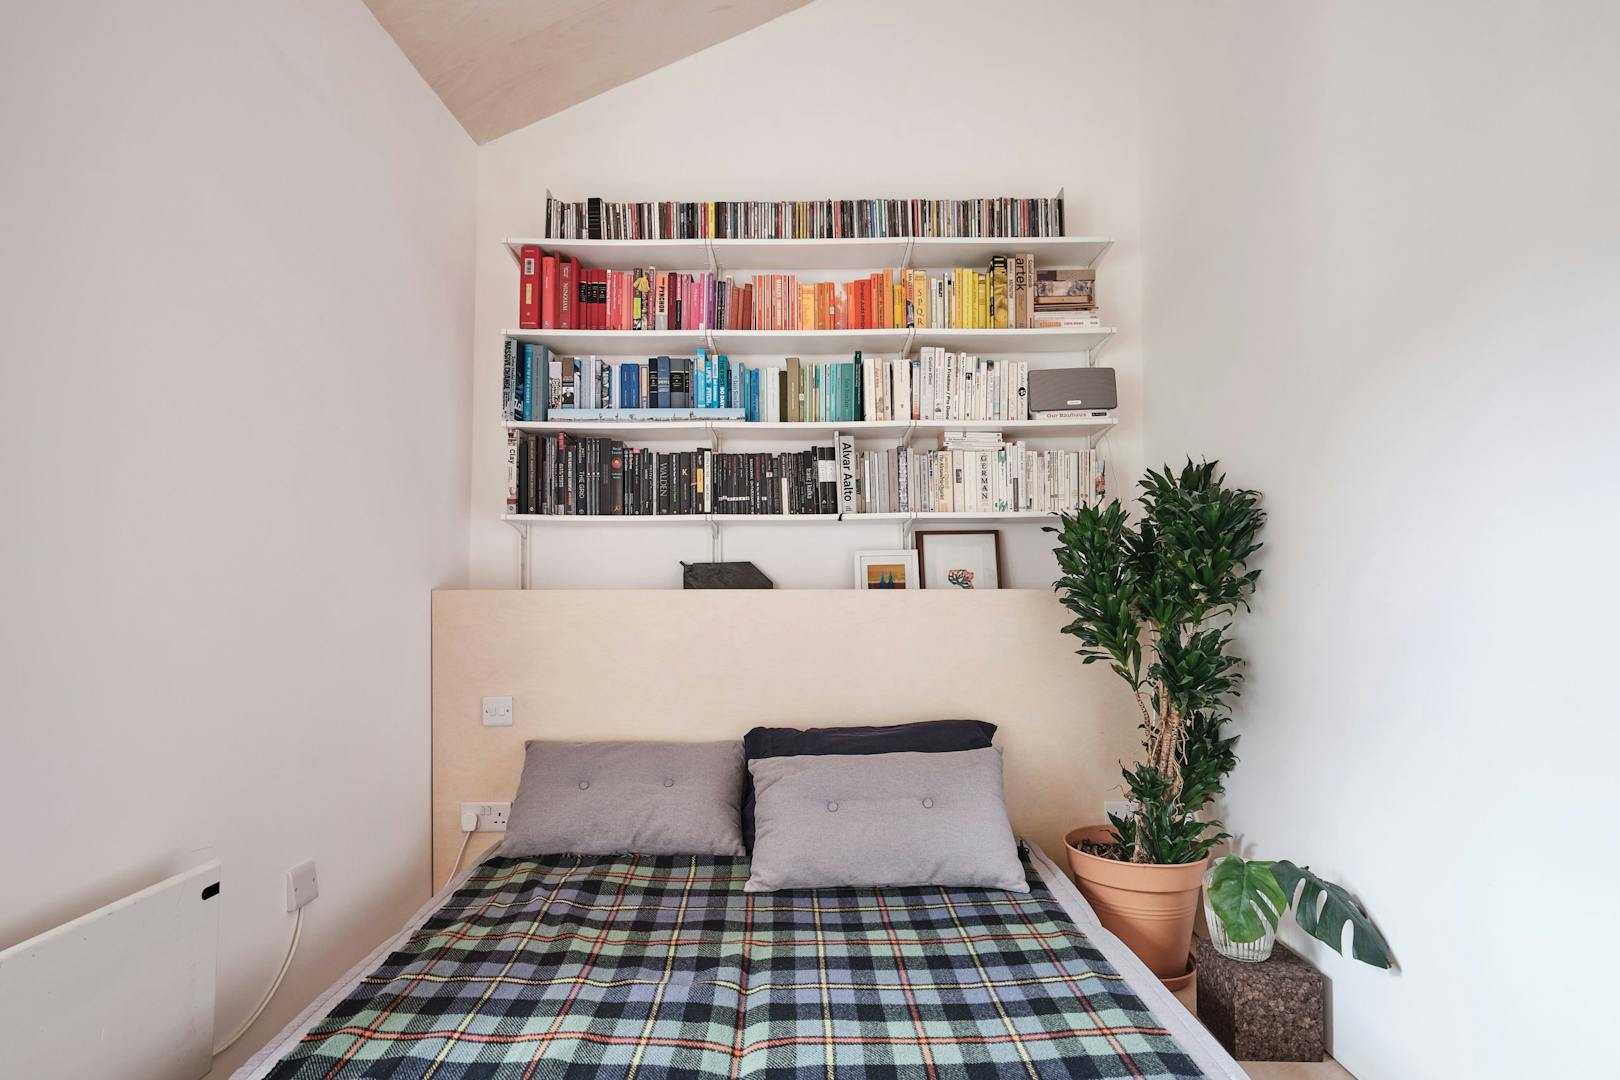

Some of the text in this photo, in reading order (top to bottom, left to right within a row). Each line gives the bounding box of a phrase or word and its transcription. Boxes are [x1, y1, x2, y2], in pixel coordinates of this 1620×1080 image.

[1016, 258, 1026, 292] artek
[504, 341, 512, 367] MASSIVE
[503, 367, 511, 390] CHANGE
[508, 448, 516, 465] Clay
[660, 463, 668, 497] WALDEN
[682, 468, 688, 476] K
[842, 442, 853, 502] Alvar Aalto
[980, 455, 989, 500] GERMAN
